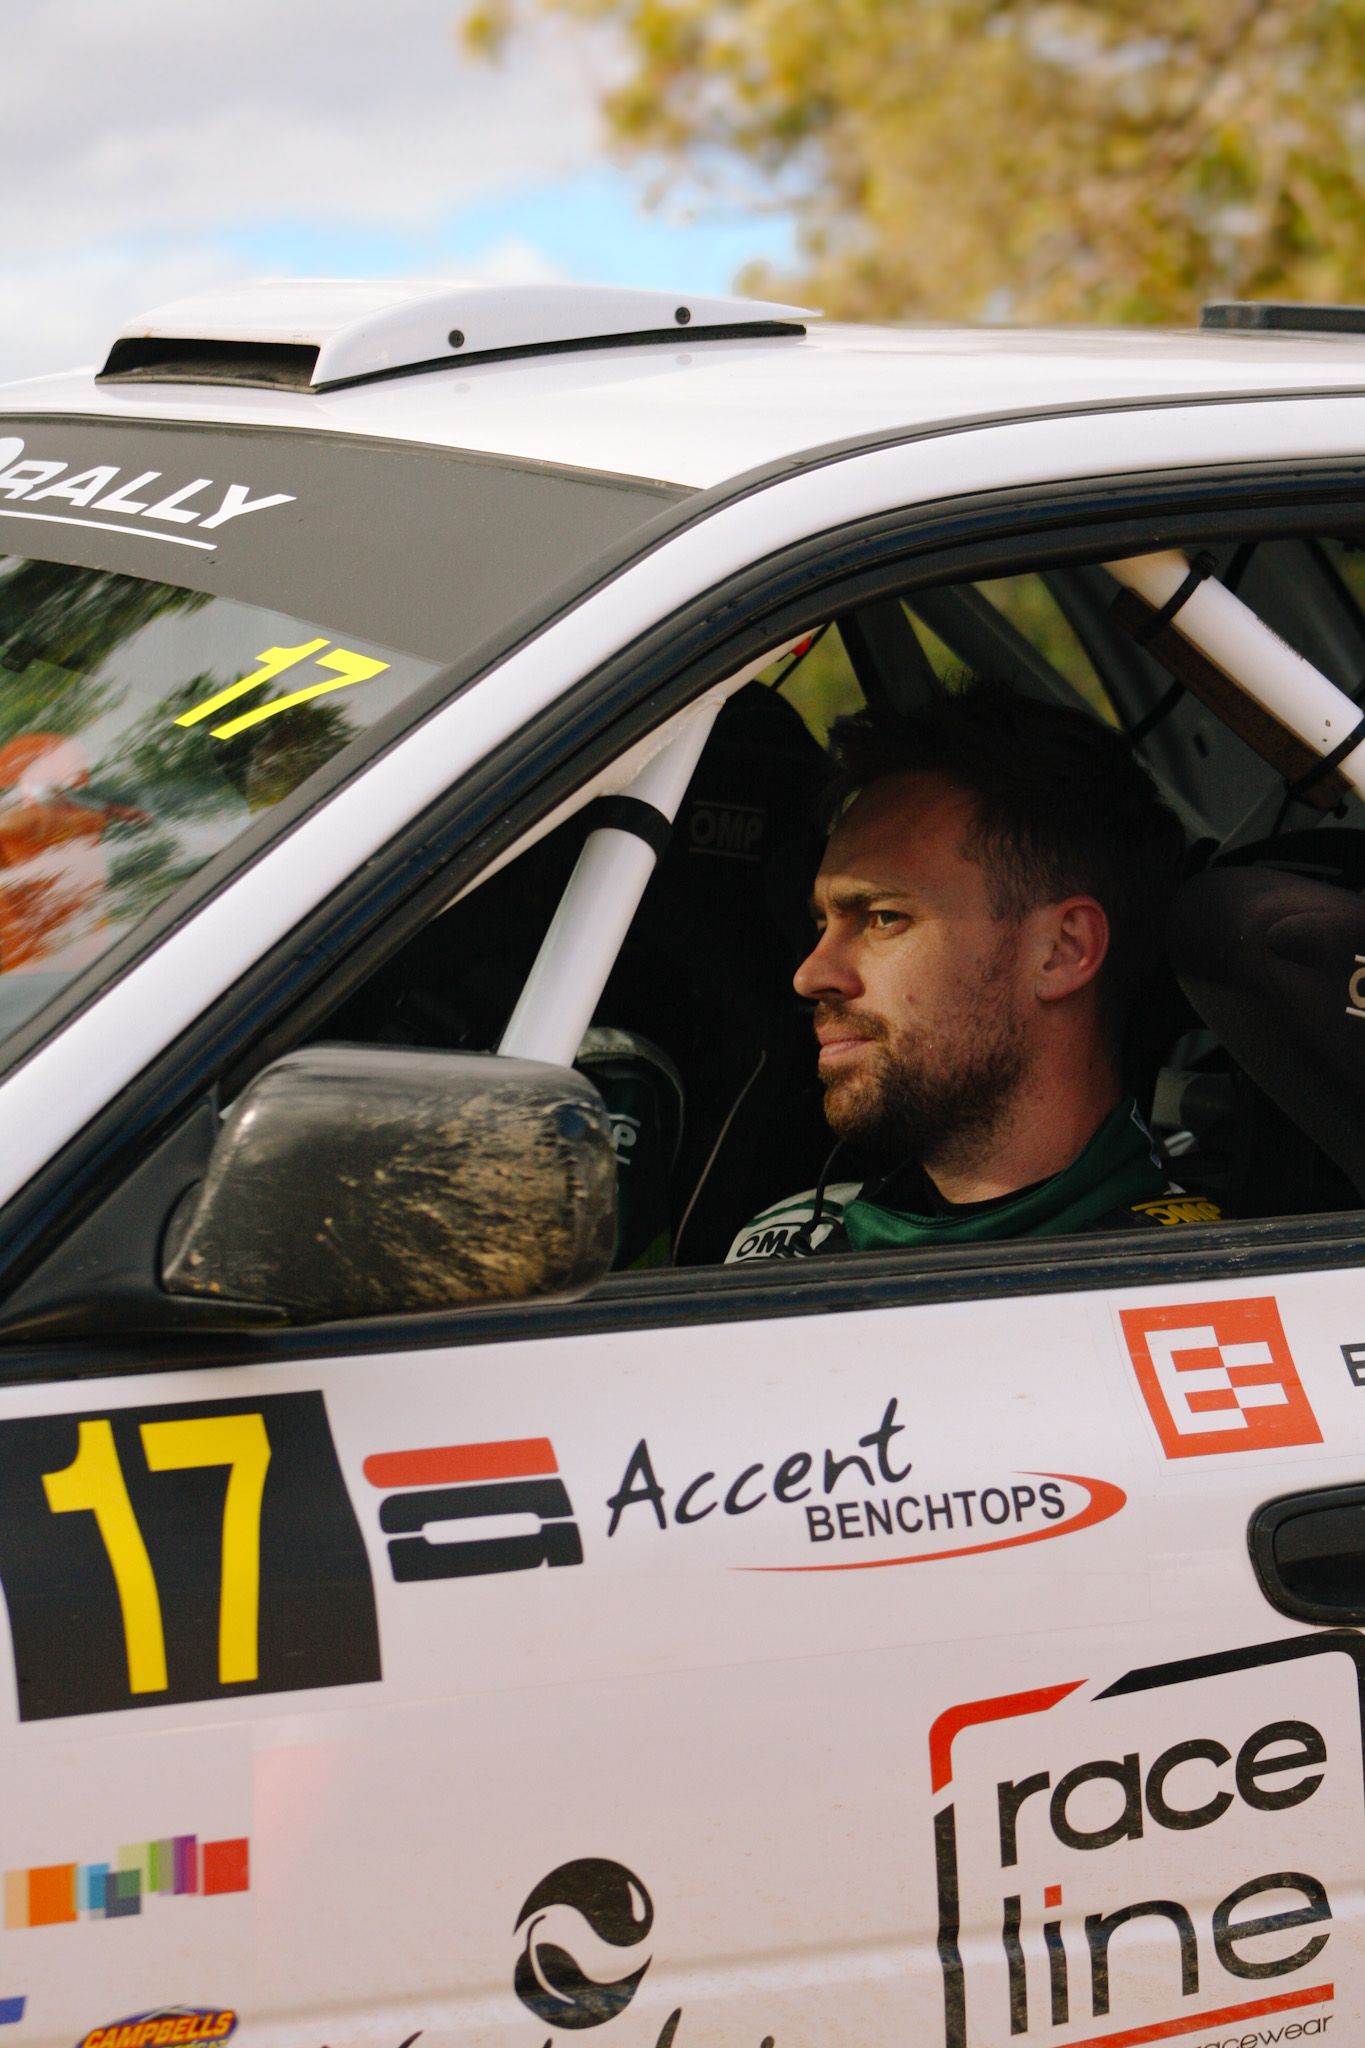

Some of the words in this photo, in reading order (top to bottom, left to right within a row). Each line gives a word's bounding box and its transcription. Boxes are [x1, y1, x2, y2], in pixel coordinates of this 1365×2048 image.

[174, 638, 391, 740] 17
[690, 808, 764, 849] OMP
[606, 1397, 912, 1538] Accent
[805, 1483, 1066, 1543] BENCHTOPS
[41, 1413, 272, 1694] 17
[997, 1720, 1327, 1868] race
[1002, 1871, 1333, 2036] line
[82, 2010, 236, 2048] CAMPBELLS
